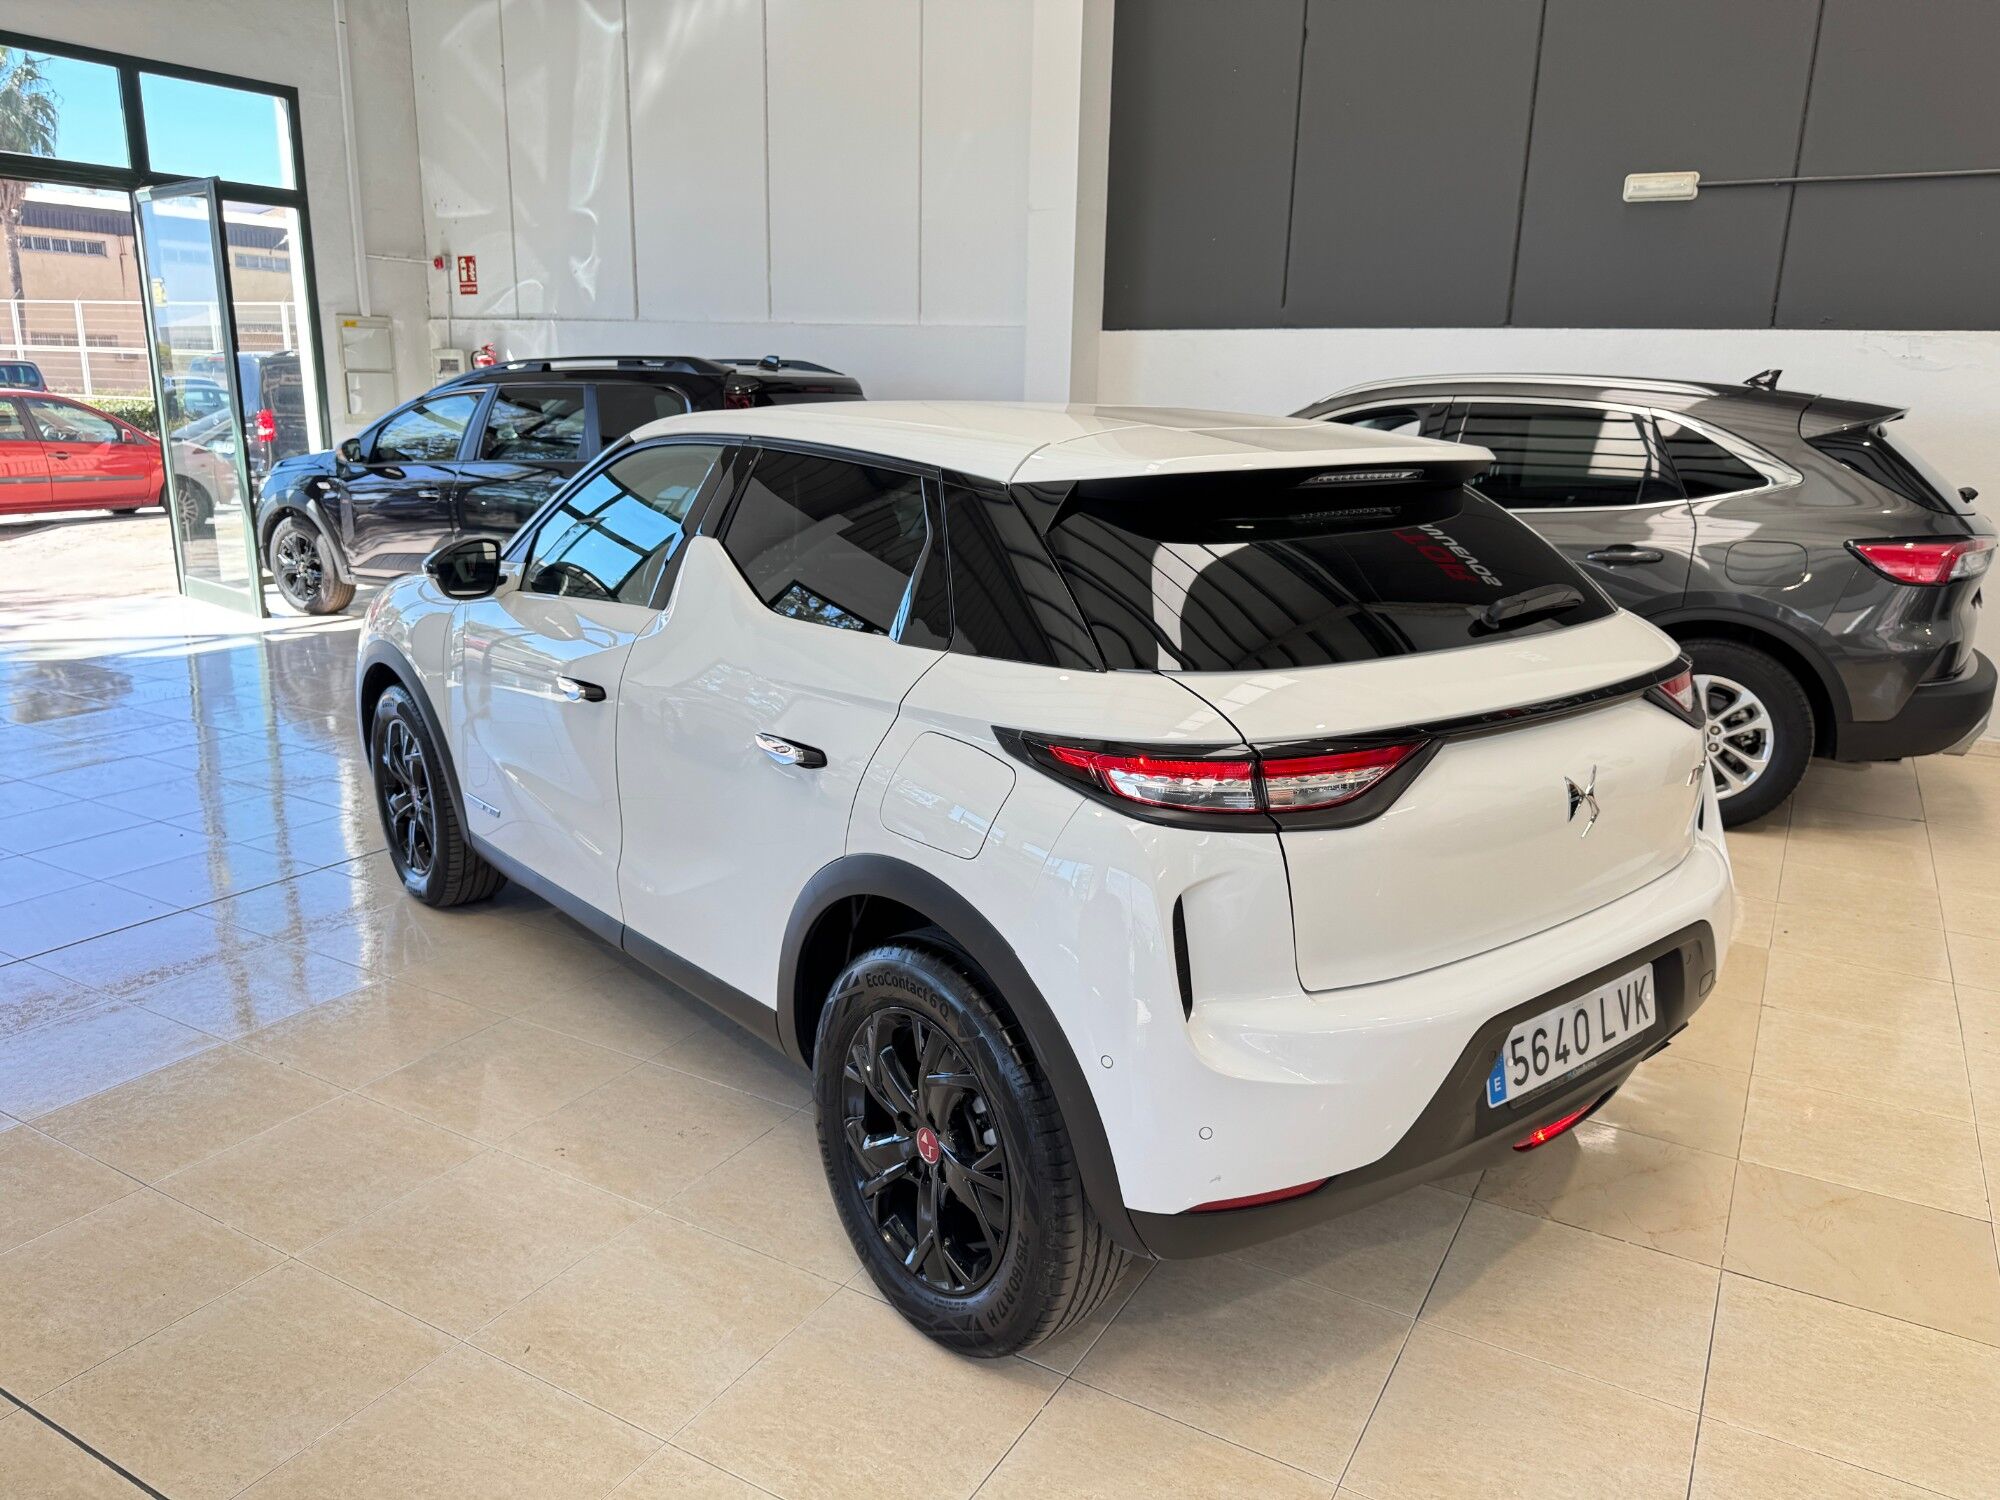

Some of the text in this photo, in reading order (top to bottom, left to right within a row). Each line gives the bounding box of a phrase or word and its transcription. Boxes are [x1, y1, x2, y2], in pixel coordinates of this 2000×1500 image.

[865, 971, 949, 1022] EcoContact 6 Q
[1510, 975, 1650, 1087] 5640 LVK
[1494, 1076, 1502, 1092] E
